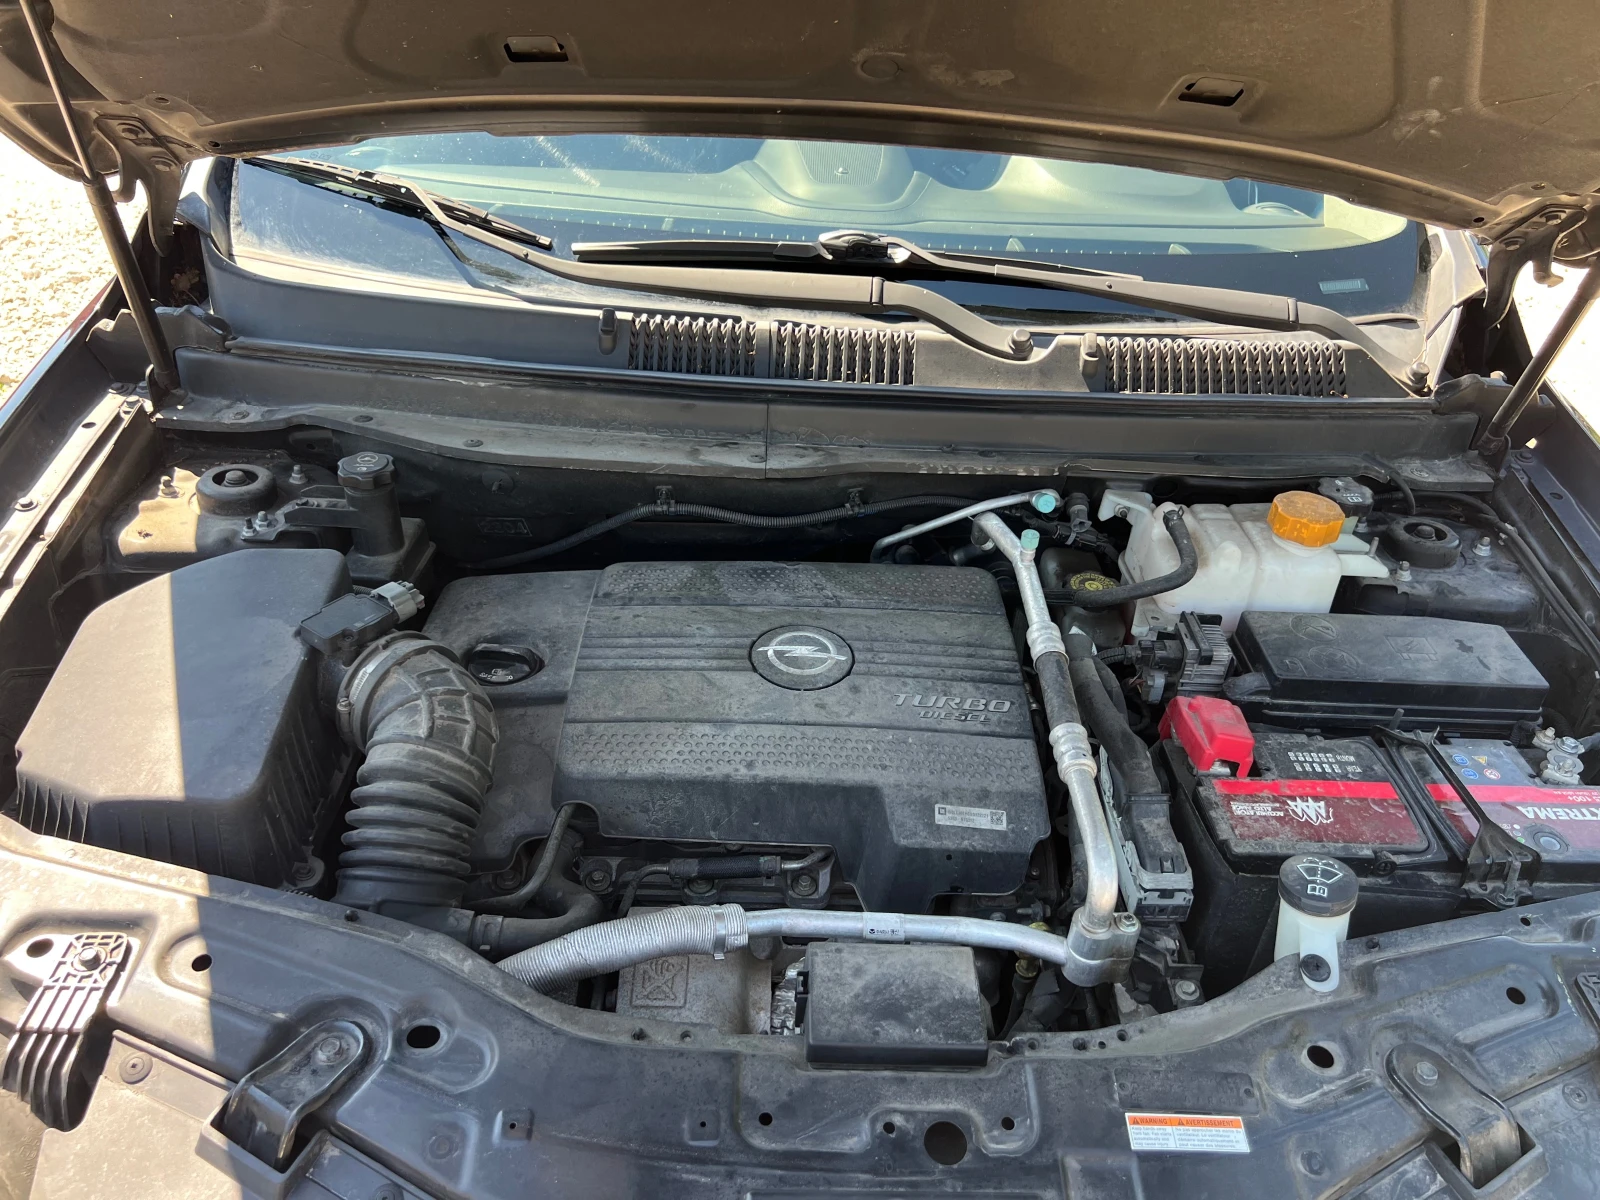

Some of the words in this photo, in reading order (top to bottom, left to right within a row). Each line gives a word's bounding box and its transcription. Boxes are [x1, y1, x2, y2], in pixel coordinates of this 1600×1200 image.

[893, 693, 1011, 713] TURBO
[918, 710, 991, 723] DIESEL
[1185, 1118, 1234, 1127] AVERTISSEMENT
